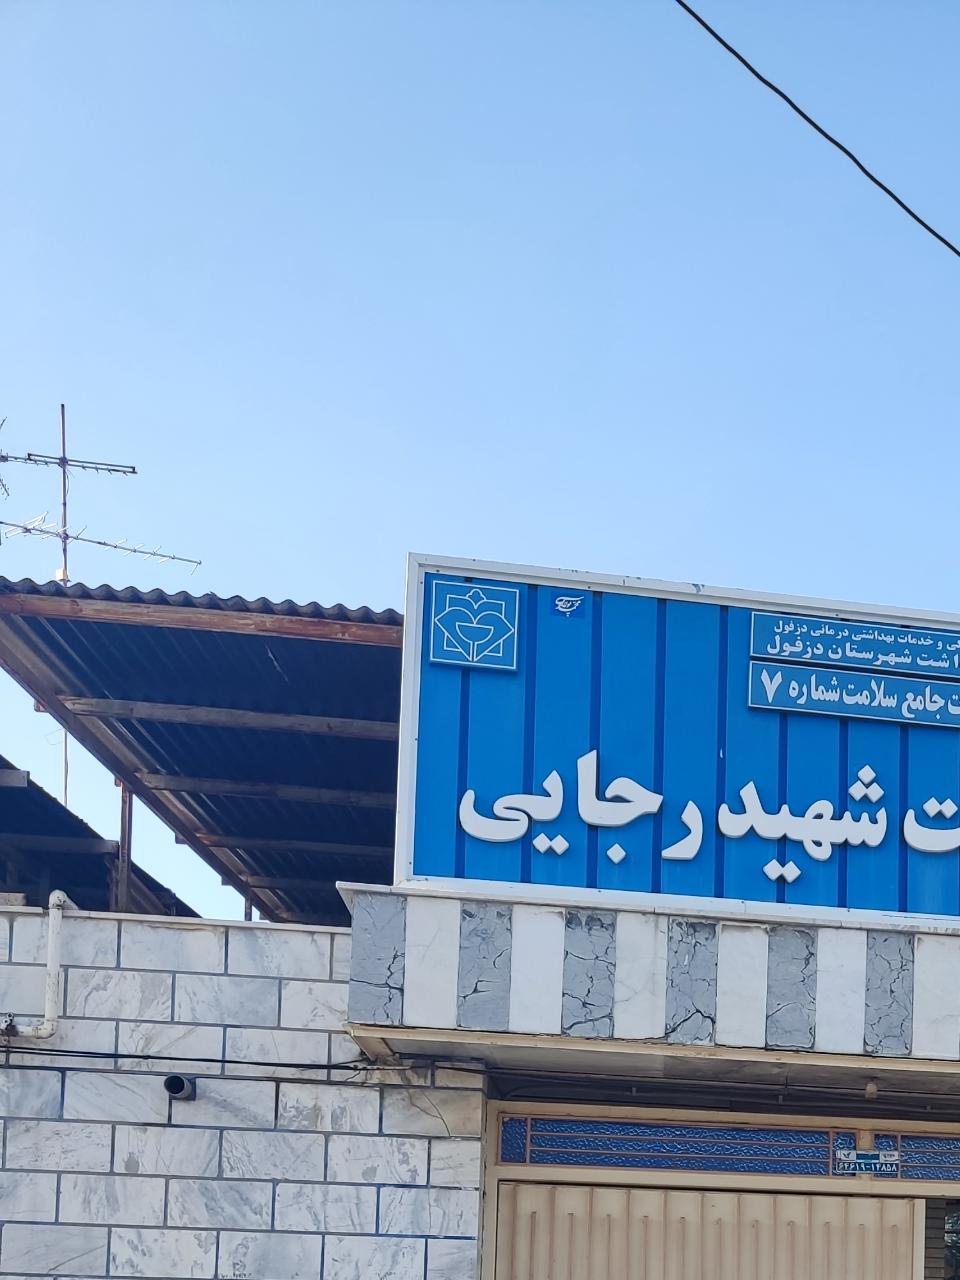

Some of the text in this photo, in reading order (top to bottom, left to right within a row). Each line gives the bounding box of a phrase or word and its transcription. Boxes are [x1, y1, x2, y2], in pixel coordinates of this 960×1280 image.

[774, 620, 807, 635] دزفول
[810, 624, 849, 639] درمانی
[851, 629, 895, 645] بهداشتی
[897, 633, 934, 646] خدمات
[766, 634, 824, 659] دزفول
[828, 641, 912, 666] شهرستان
[936, 640, 943, 650] و
[761, 668, 783, 704] ۷
[788, 673, 840, 705] شماره
[843, 679, 897, 709] سلامت
[901, 685, 945, 720] جامع
[458, 749, 704, 866] رجایی
[717, 763, 888, 885] شهید
